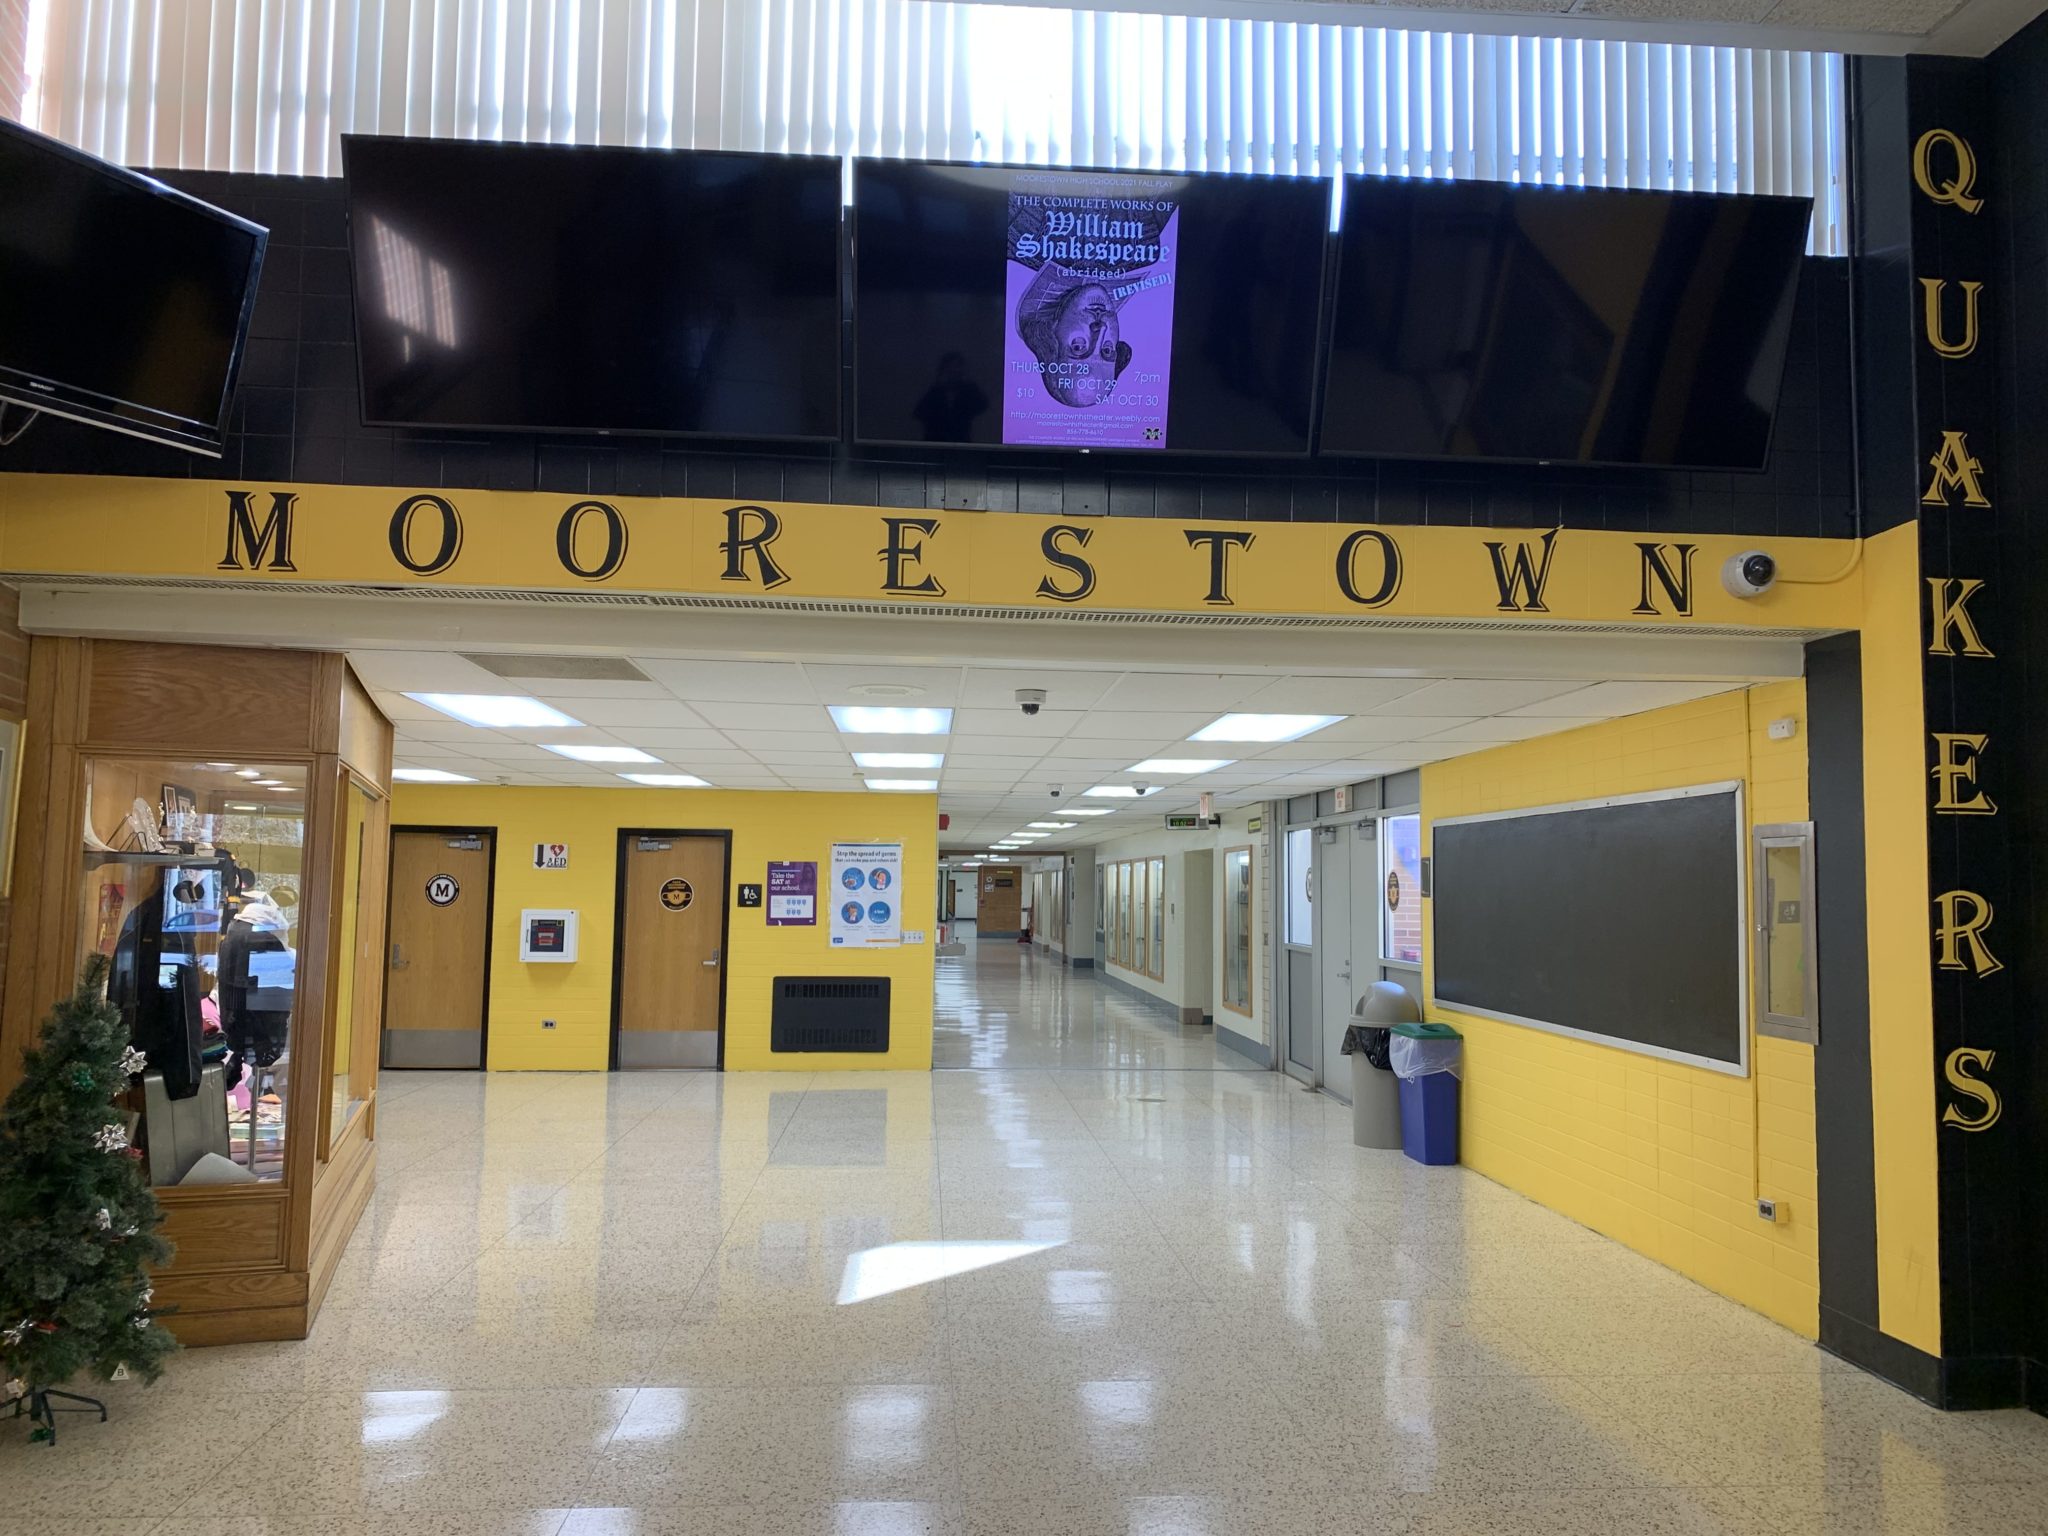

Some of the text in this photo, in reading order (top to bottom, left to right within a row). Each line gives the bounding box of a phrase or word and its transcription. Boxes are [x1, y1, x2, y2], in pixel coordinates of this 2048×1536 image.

[1015, 195, 1174, 212] THE COMPLETE WORKS OF
[1046, 210, 1144, 239] William
[1015, 233, 1170, 265] Shakespeare
[1056, 266, 1126, 280] (abridged)
[1112, 273, 1172, 300] [REVISED]
[1011, 362, 1090, 375] THURS OCT 28
[1058, 378, 1117, 391] FRI OCT 29
[1134, 371, 1161, 385] 7pm
[1017, 388, 1035, 399] $10
[1095, 394, 1159, 407] SAT OCT 30
[216, 490, 1698, 616] MOORESTOWN
[1913, 128, 2004, 1132] QUAKERS
[546, 857, 567, 867] AED
[435, 883, 450, 897] M
